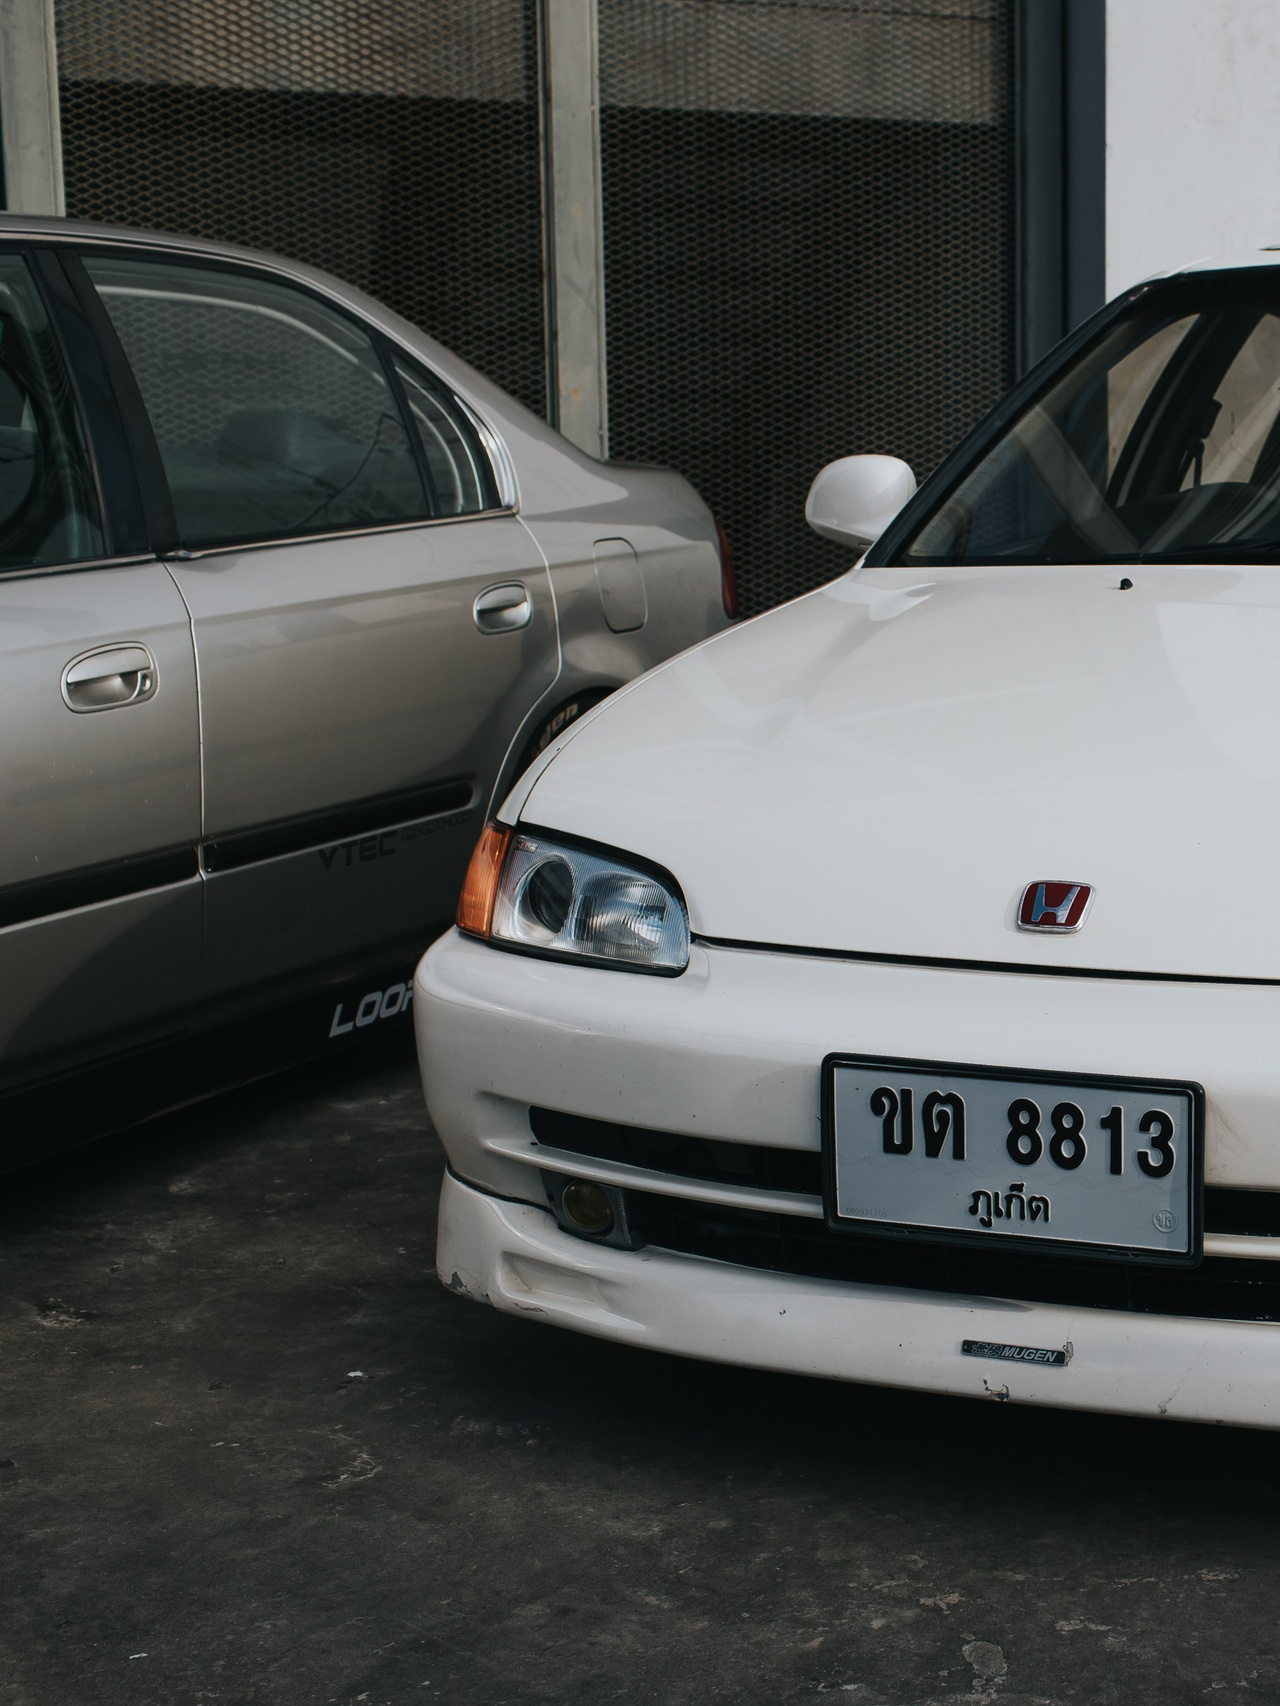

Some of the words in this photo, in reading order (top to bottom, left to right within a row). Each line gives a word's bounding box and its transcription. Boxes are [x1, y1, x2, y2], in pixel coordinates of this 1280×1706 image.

[317, 829, 398, 872] VTEC
[401, 809, 474, 842] DOHC
[870, 1085, 967, 1160] ขต
[1006, 1097, 1176, 1178] 8813
[967, 1182, 1051, 1228] ภูเก็ต
[1001, 1346, 1058, 1362] MUGEN
